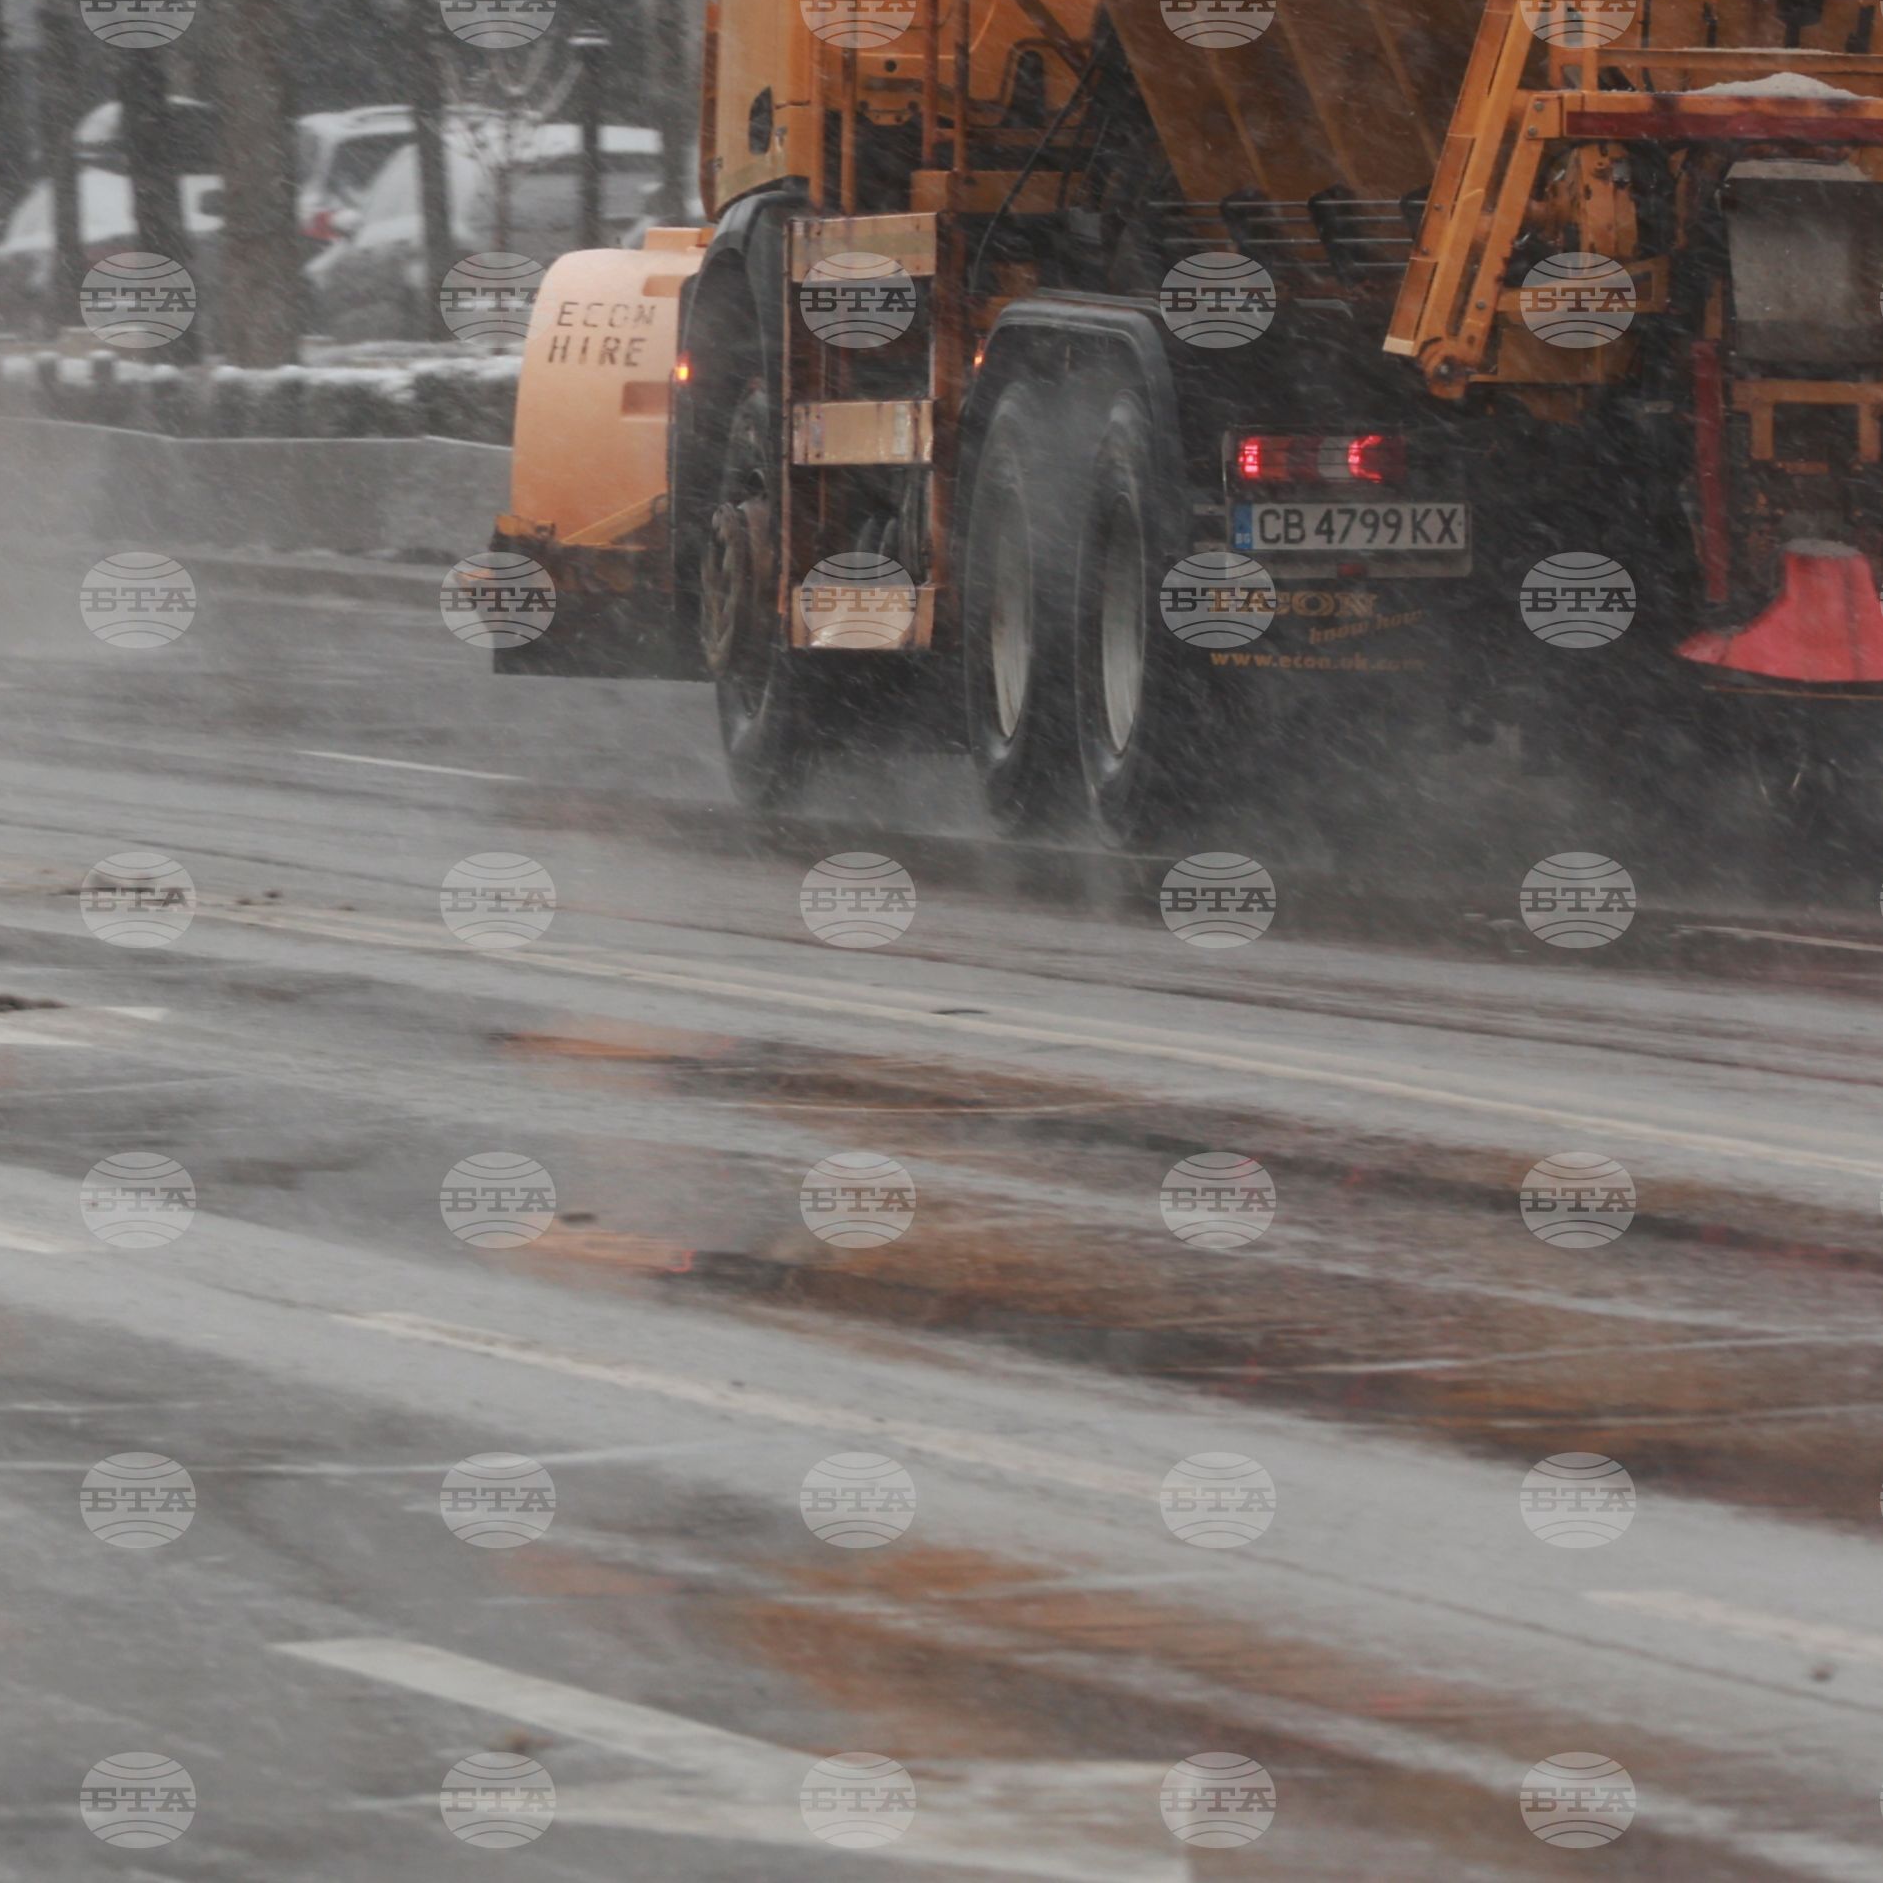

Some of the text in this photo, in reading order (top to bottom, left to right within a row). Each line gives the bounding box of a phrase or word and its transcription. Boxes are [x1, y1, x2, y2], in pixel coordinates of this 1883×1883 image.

[548, 335, 648, 366] HIRE
[1258, 508, 1306, 545] CB
[1315, 507, 1403, 545] 4799
[1411, 507, 1459, 545] KX
